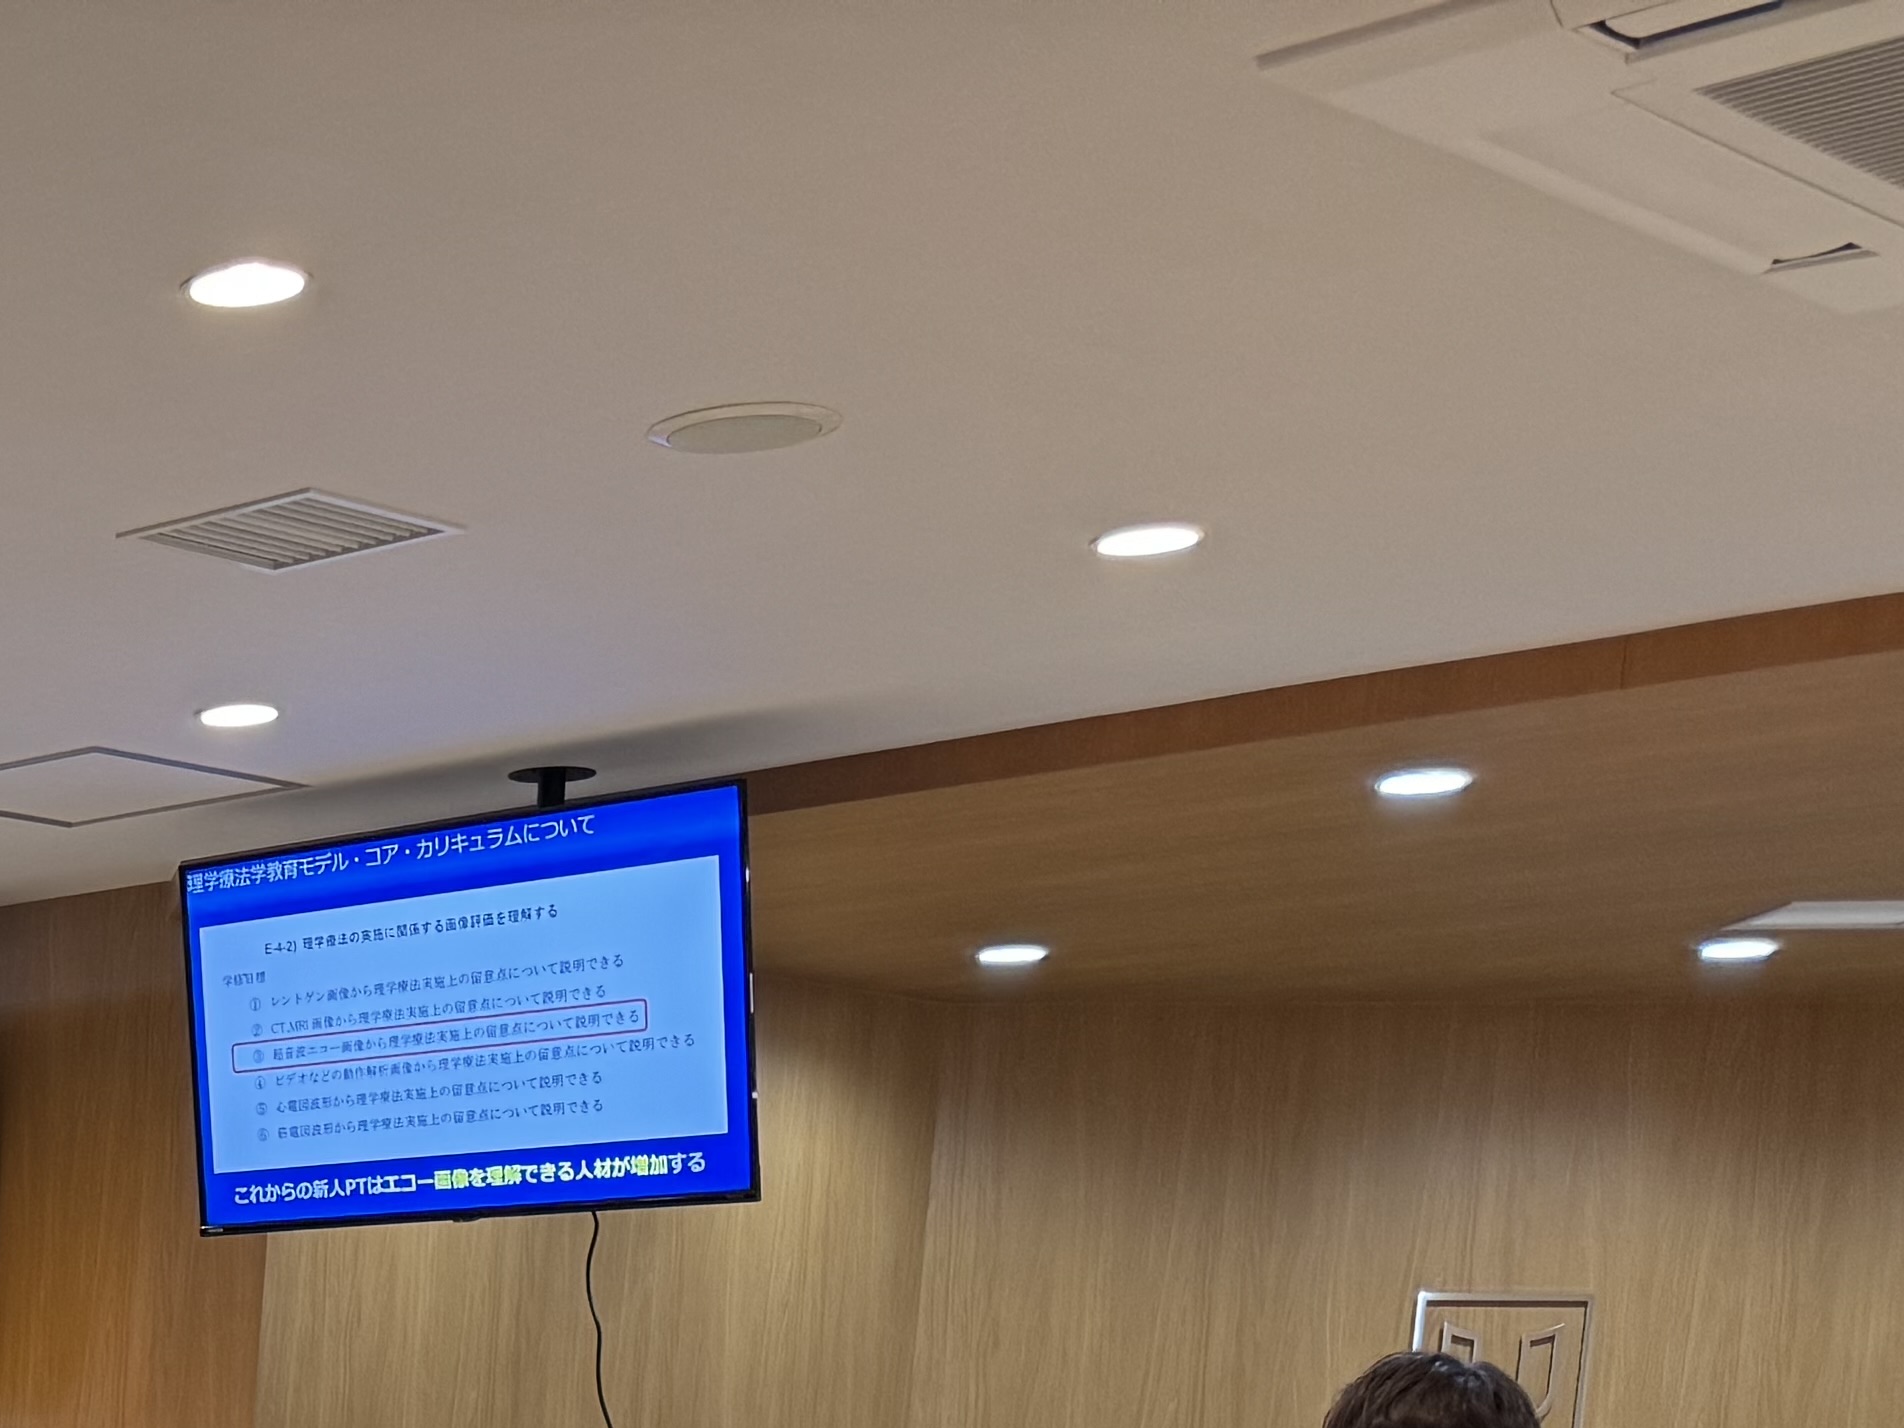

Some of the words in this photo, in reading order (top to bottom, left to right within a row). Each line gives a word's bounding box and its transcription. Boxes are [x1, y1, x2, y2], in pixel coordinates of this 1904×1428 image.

[234, 1151, 706, 1205] これからの新人PTはエコー画像を理解できる人材が増加する
